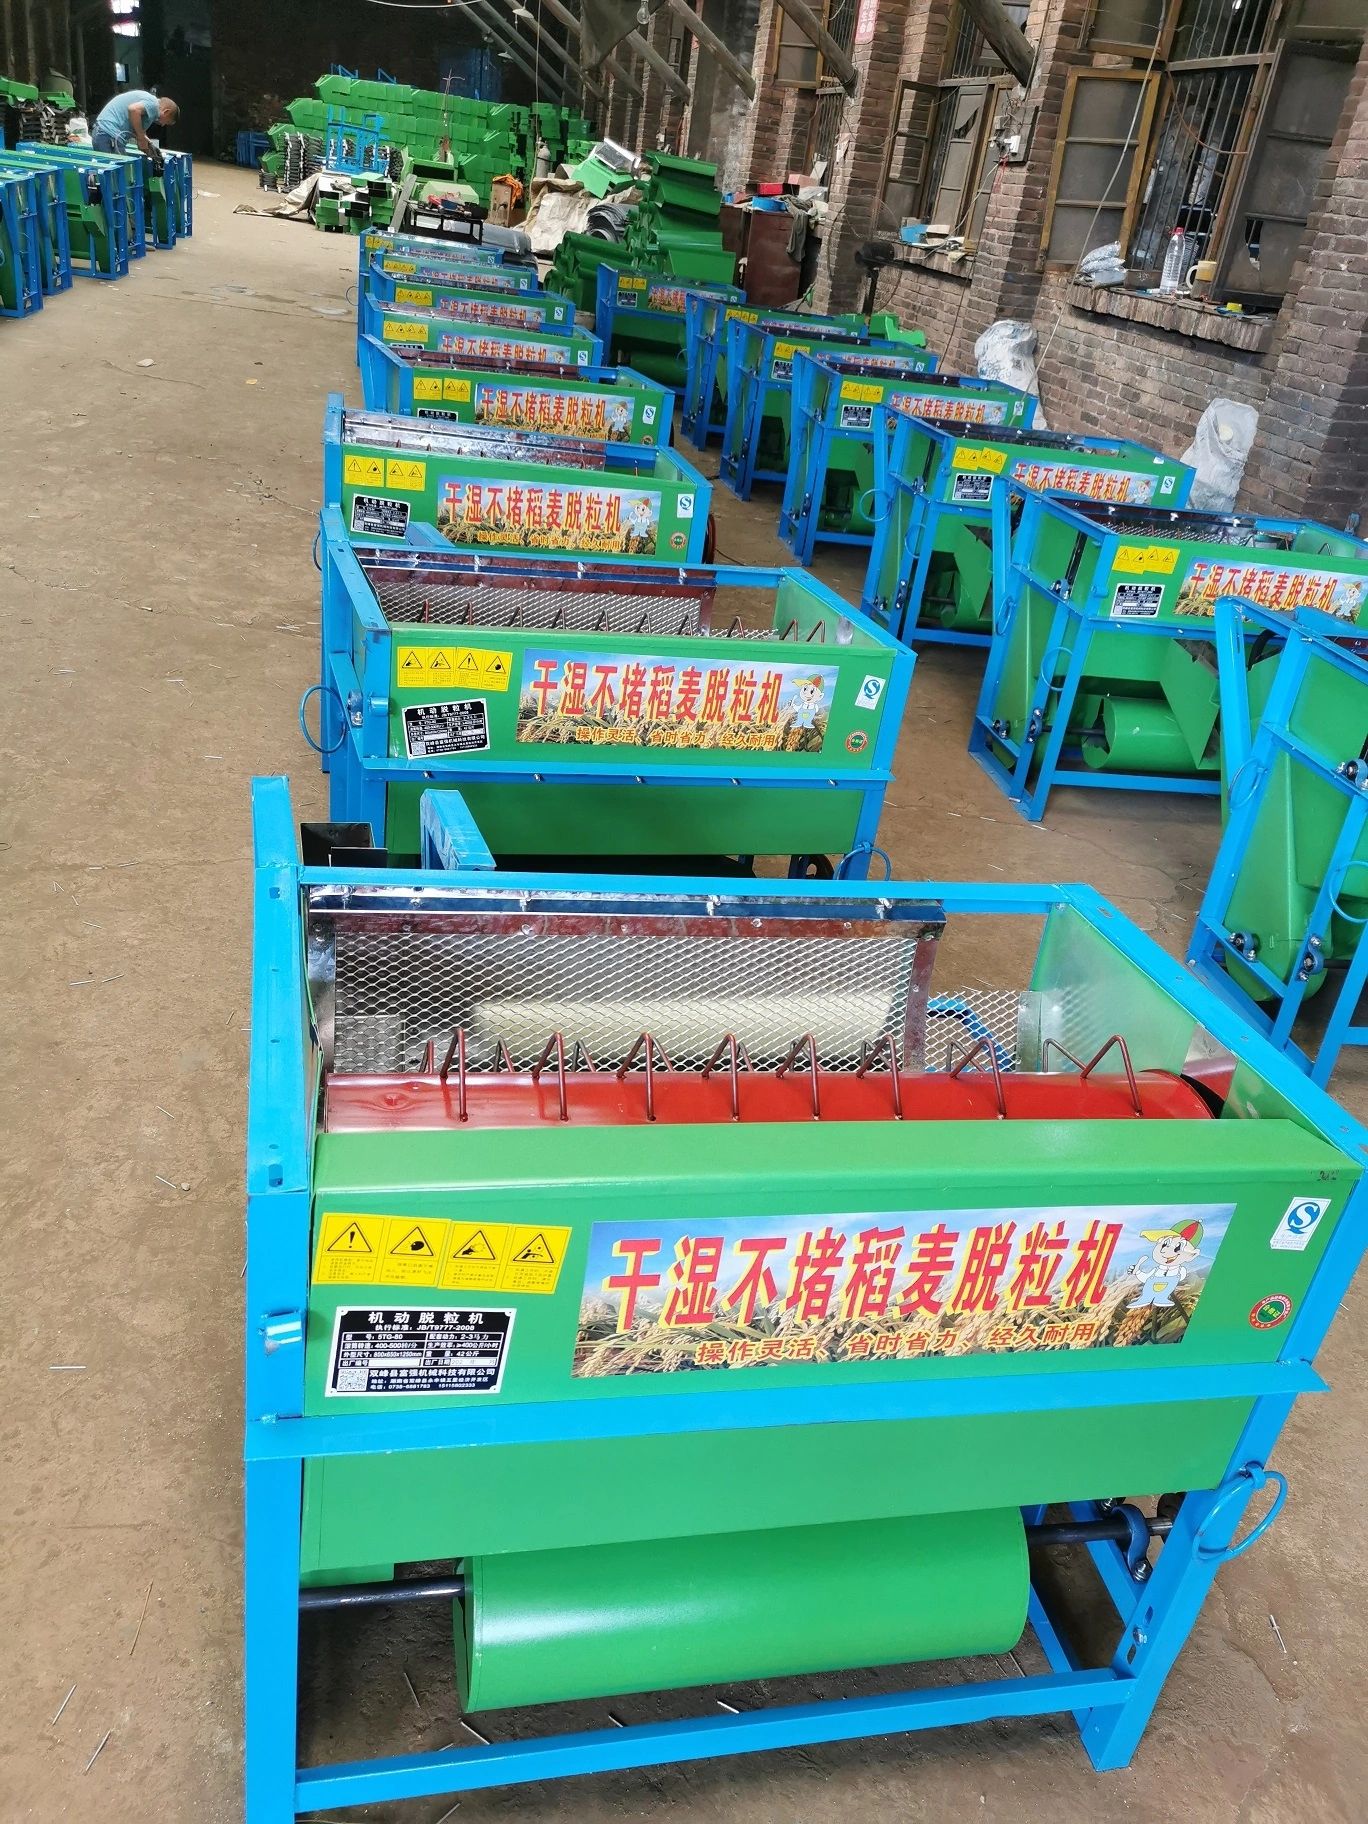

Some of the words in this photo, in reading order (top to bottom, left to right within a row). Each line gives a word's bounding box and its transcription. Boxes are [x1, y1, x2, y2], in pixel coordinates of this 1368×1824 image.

[482, 388, 606, 429] 干湿不堵稻麦脱粒机
[445, 483, 621, 534] 干湿不堵稻麦脱粒机
[1188, 563, 1338, 610] 干湿不堵稻麦脱粒机
[530, 659, 784, 725] 干湿不堵稻麦脱粒机
[600, 1219, 1124, 1332] 干湿不堵稻麦脱粒机
[368, 1311, 484, 1325] 机动脱粒机
